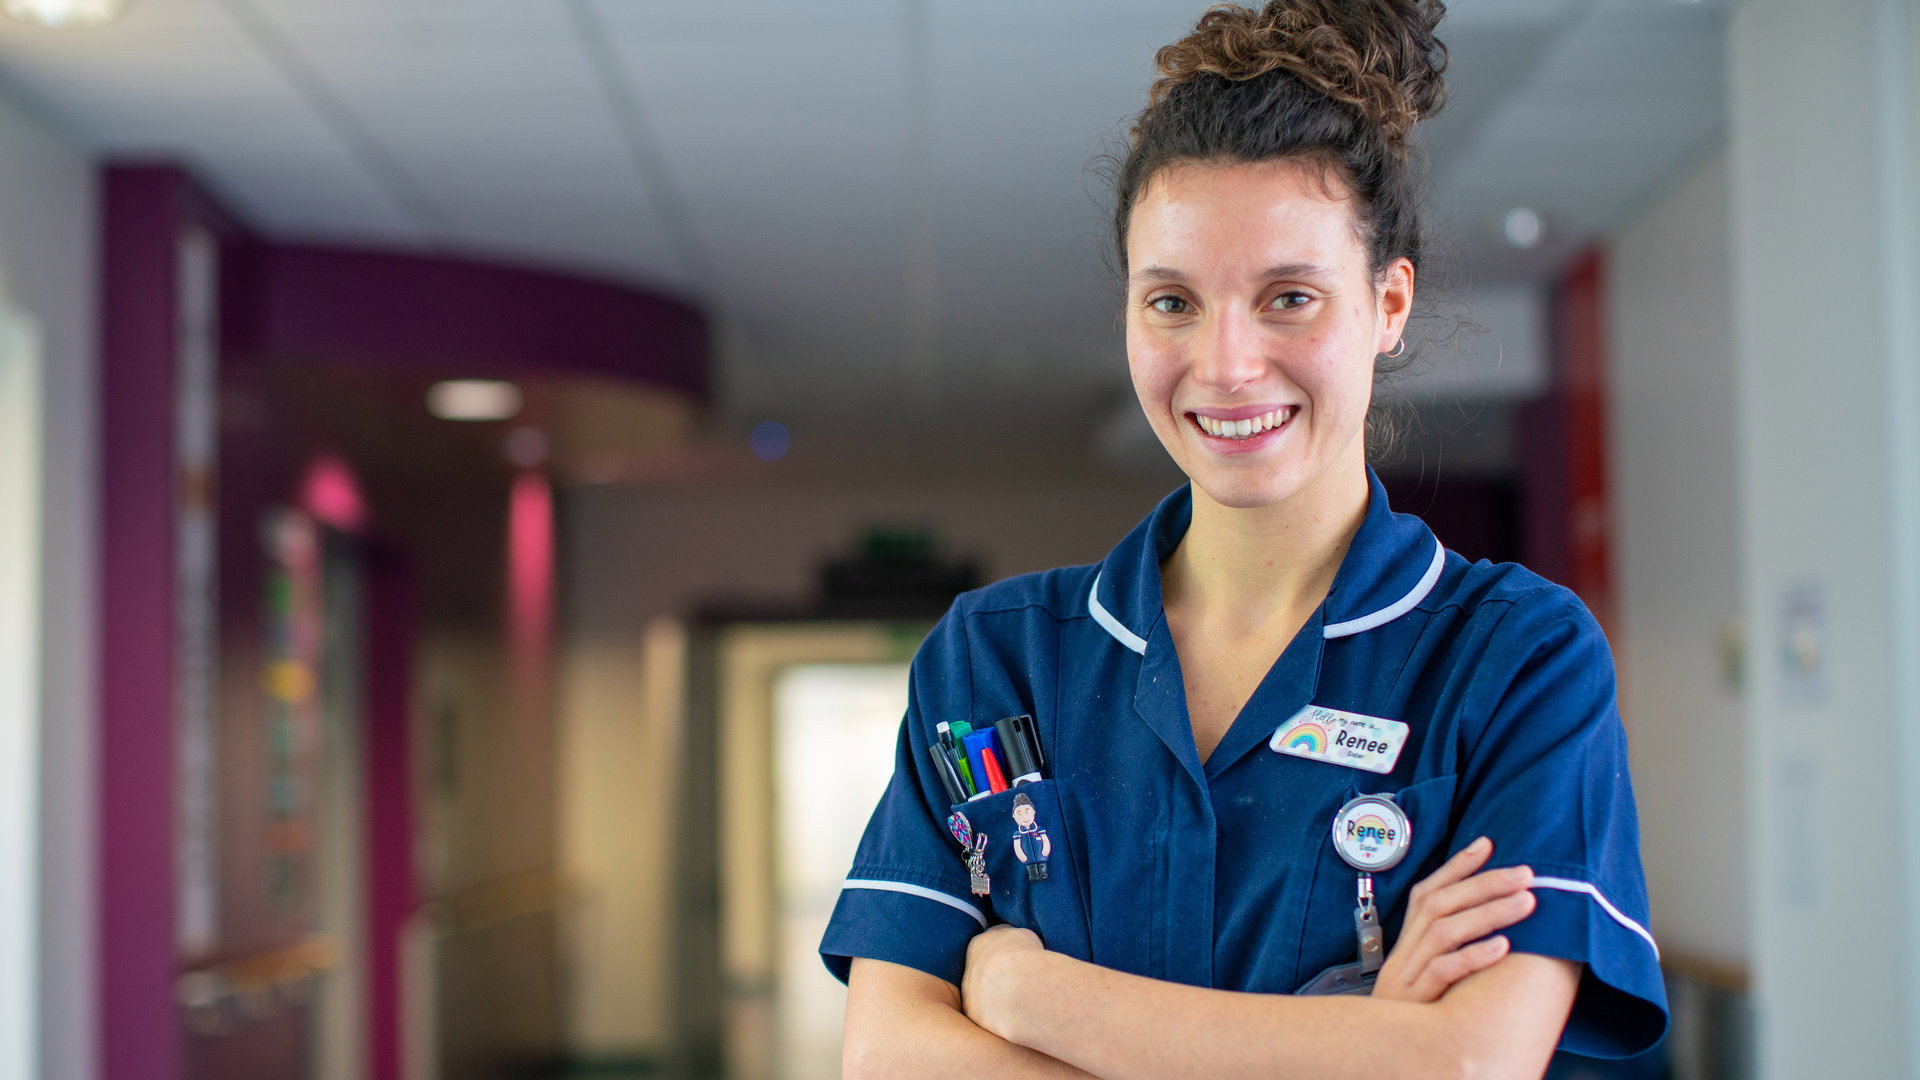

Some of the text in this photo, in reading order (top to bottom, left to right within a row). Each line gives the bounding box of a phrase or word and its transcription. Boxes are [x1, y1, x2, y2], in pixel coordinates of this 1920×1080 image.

[1310, 709, 1337, 725] Hello
[1338, 717, 1348, 727] my
[1350, 720, 1366, 728] name
[1335, 729, 1388, 754] Renee
[1346, 819, 1396, 841] Renee
